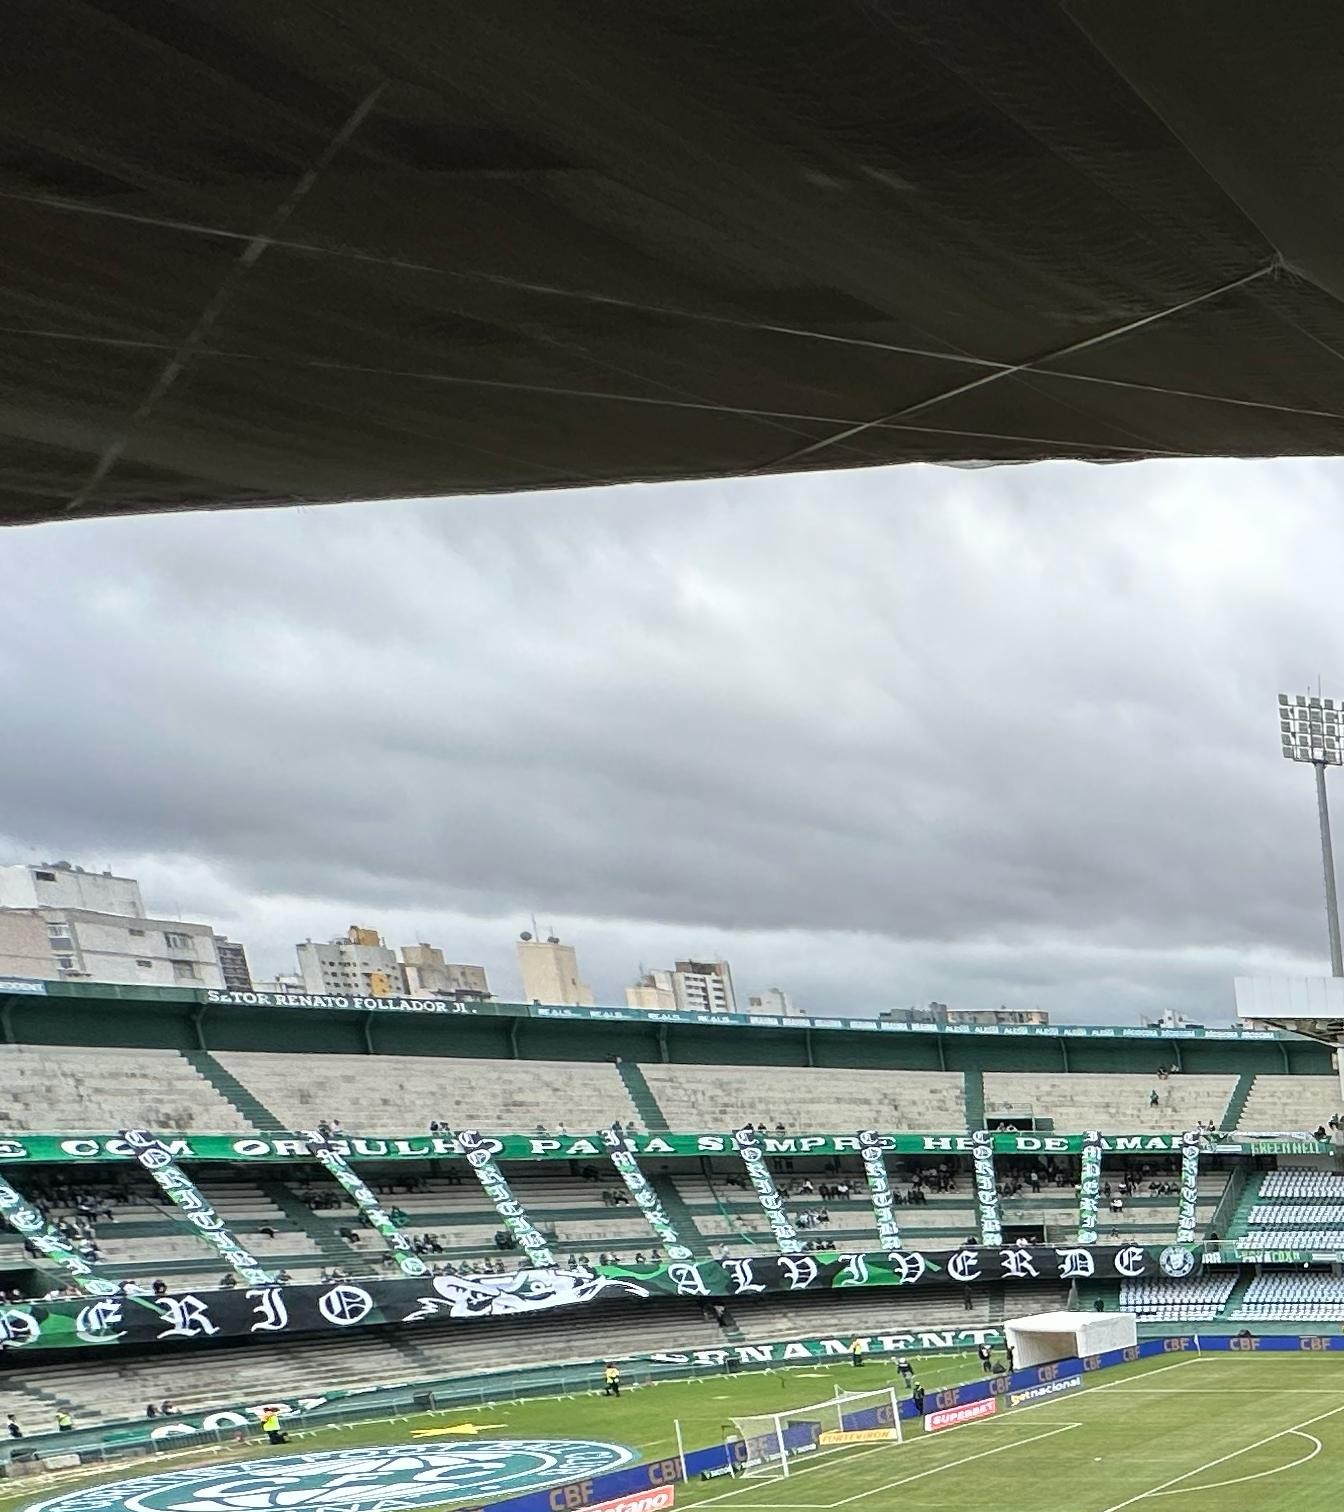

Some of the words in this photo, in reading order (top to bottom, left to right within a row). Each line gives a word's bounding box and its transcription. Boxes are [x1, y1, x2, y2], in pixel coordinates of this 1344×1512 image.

[276, 993, 348, 1008] RENATO
[353, 997, 447, 1012] FOLLADOR
[697, 1136, 897, 1154] SMPRE
[1016, 1136, 1069, 1151] DE
[668, 1246, 1146, 1297] ALVIVERDE
[1163, 1338, 1189, 1351] CBF
[1230, 1337, 1260, 1351] CBF
[1300, 1337, 1331, 1351] CBF
[1038, 1364, 1059, 1382] CBF
[936, 1388, 960, 1410] CBF
[932, 1403, 994, 1426] SUPERBET
[549, 1481, 594, 1511] CBF
